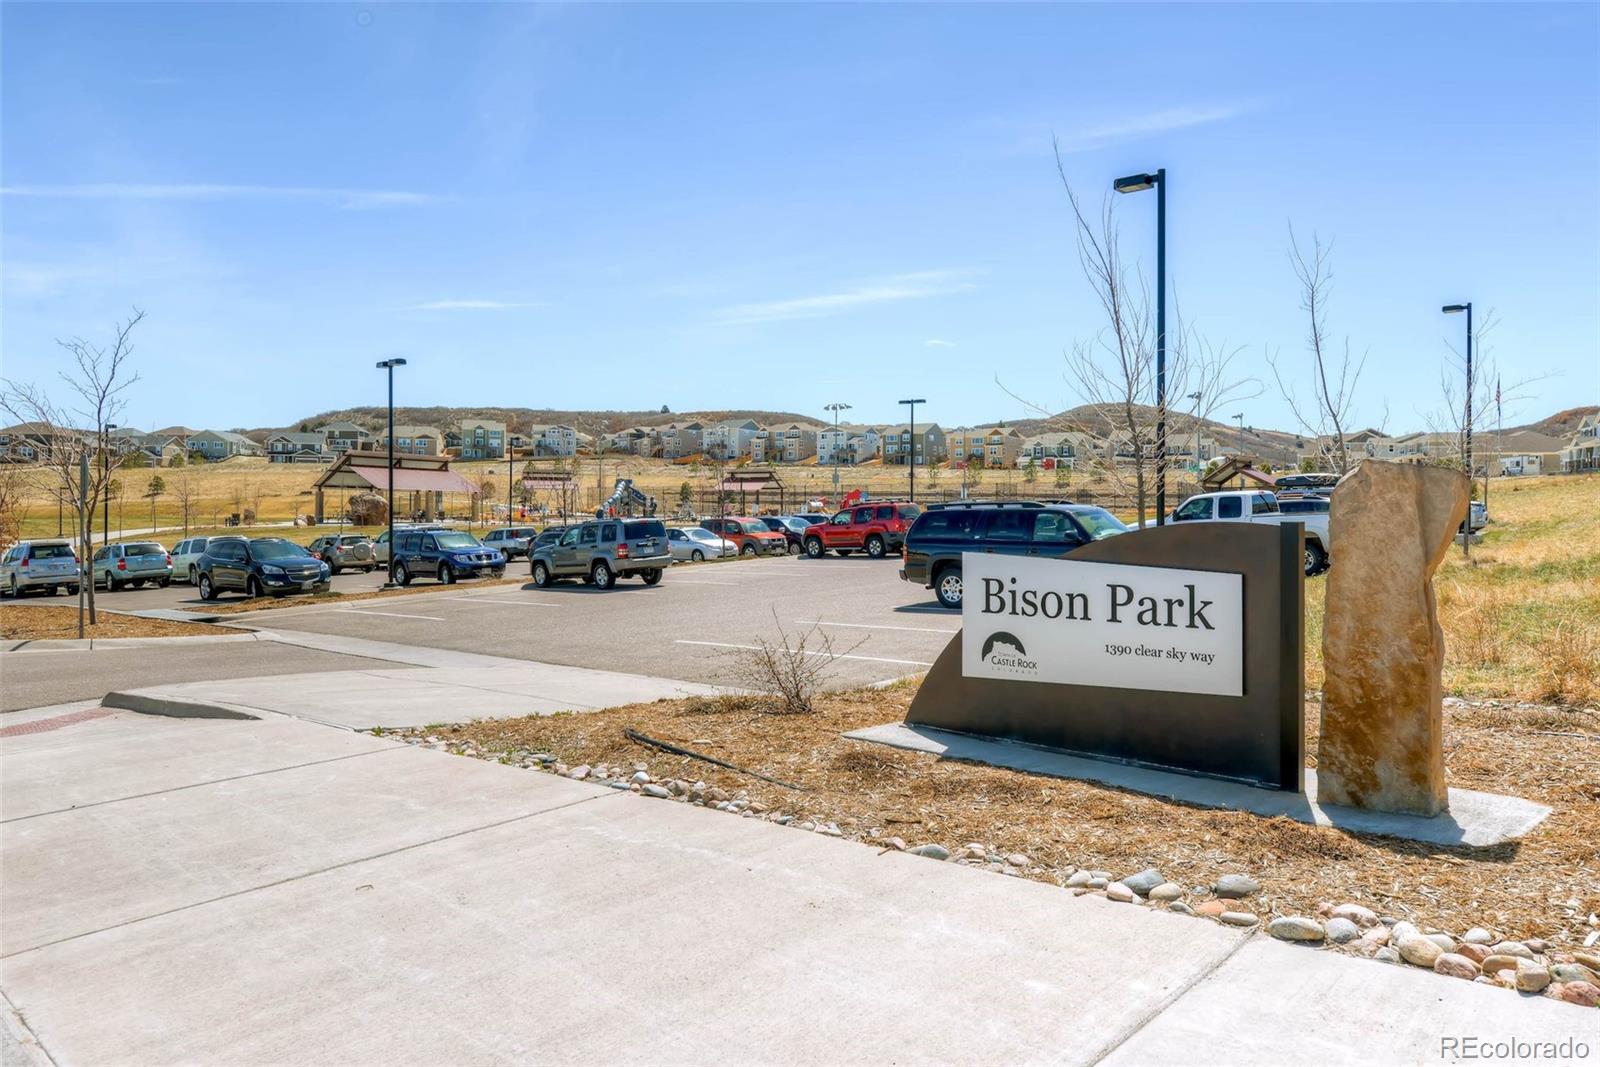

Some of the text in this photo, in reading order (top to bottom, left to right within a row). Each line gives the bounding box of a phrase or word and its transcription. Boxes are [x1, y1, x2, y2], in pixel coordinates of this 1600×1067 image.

[981, 577, 1216, 630] Bison Park
[1017, 658, 1038, 669] ROCK
[1105, 644, 1215, 665] 1390 clear sky way
